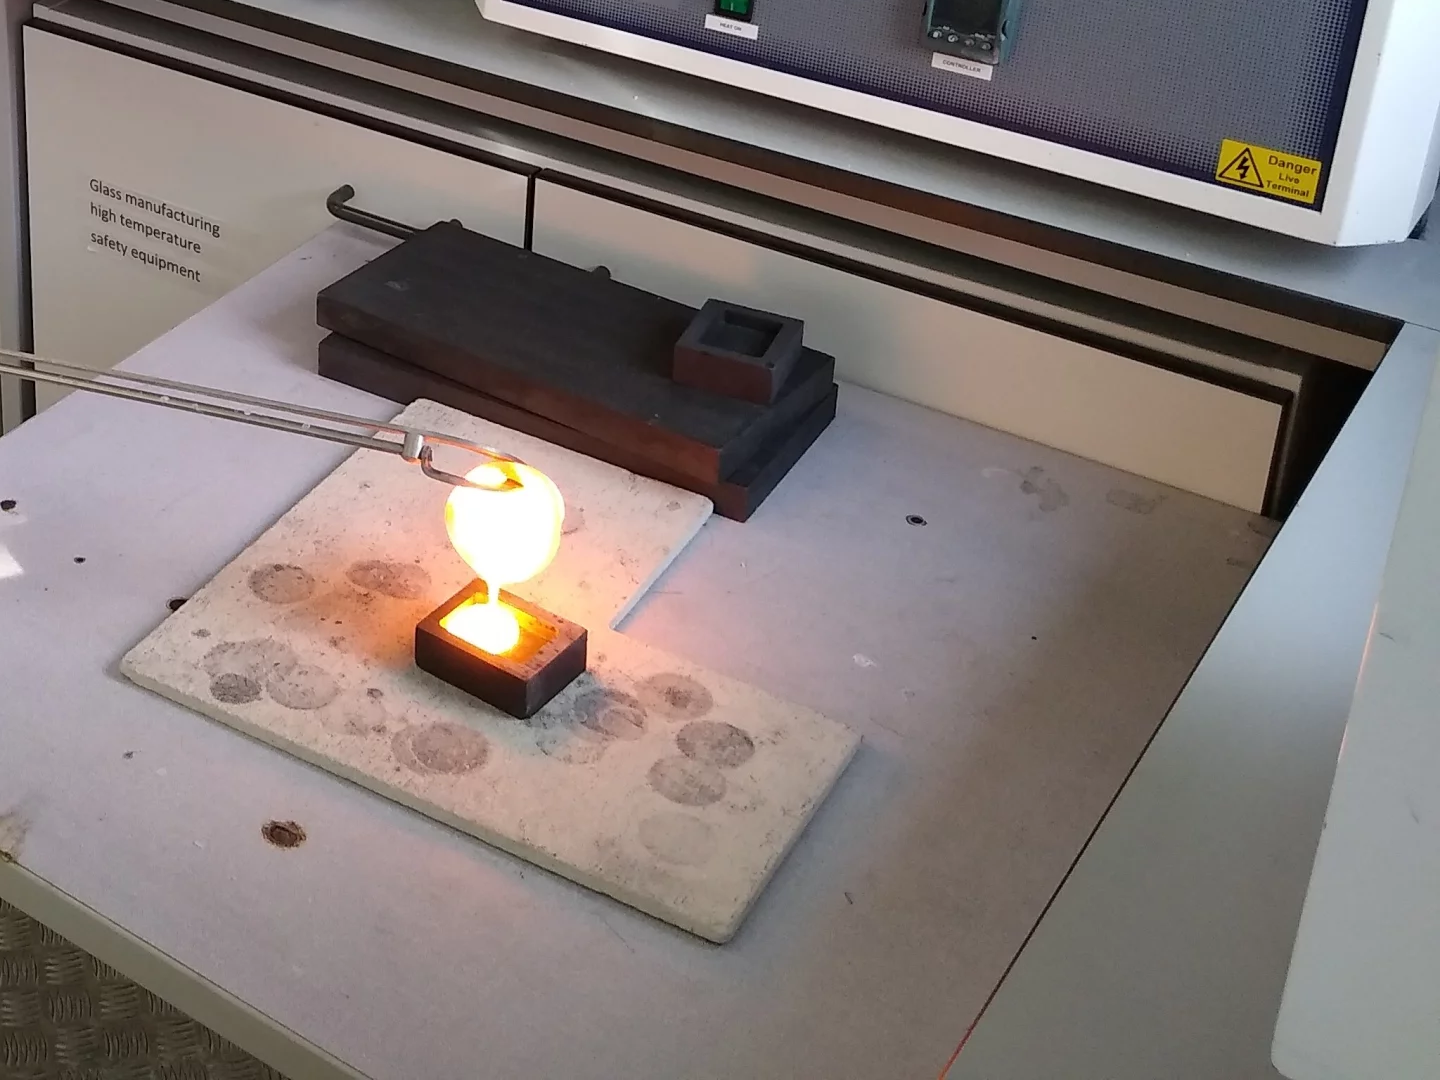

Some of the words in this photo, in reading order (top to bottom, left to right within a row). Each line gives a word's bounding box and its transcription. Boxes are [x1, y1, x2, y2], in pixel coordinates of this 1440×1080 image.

[719, 22, 734, 30] HEAT
[942, 59, 982, 73] CONTROLLER
[1268, 155, 1317, 175] Danger
[1278, 172, 1300, 184] Live
[1267, 180, 1310, 198] Terminal
[89, 178, 122, 201] Glass
[125, 193, 220, 239] manufacturing
[90, 201, 116, 223] high
[119, 214, 201, 254] temperature
[91, 232, 128, 256] safety
[130, 248, 201, 283] equipment
